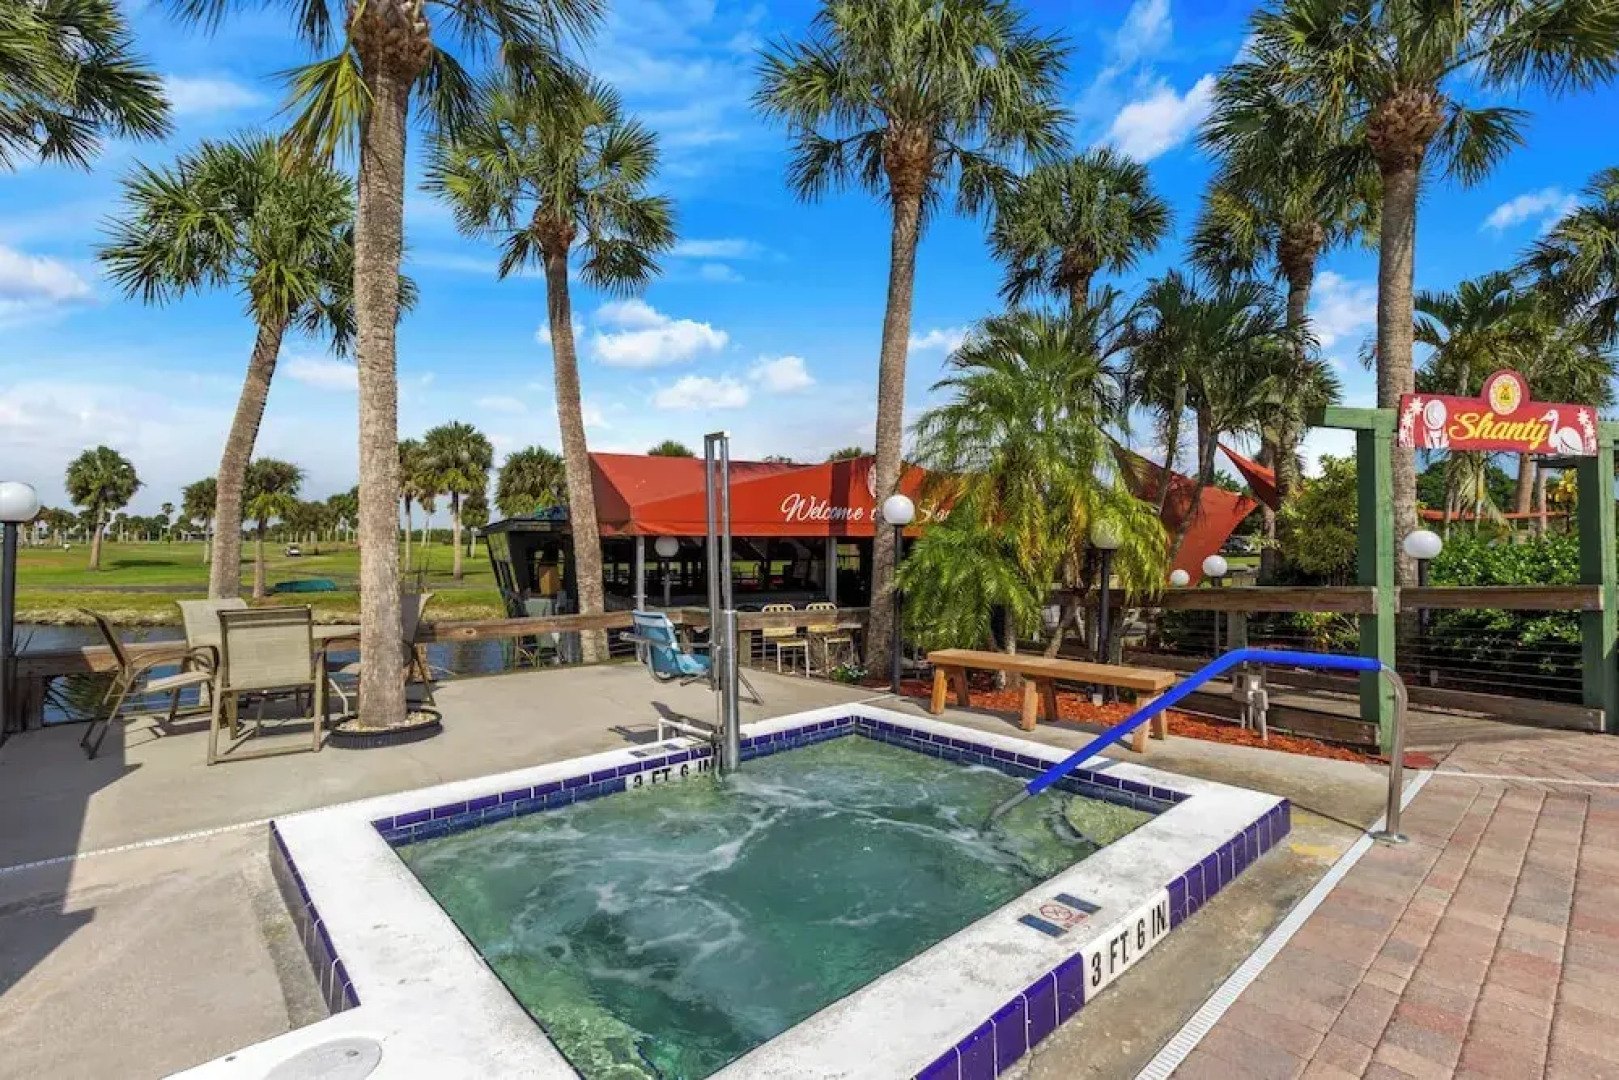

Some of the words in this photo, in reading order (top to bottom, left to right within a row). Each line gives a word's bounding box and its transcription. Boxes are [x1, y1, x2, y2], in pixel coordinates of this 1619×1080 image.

[1448, 411, 1548, 450] Shanty
[781, 493, 864, 522] Welcome
[681, 764, 690, 777] 6
[1091, 951, 1101, 987] 3
[1137, 918, 1145, 950] 6
